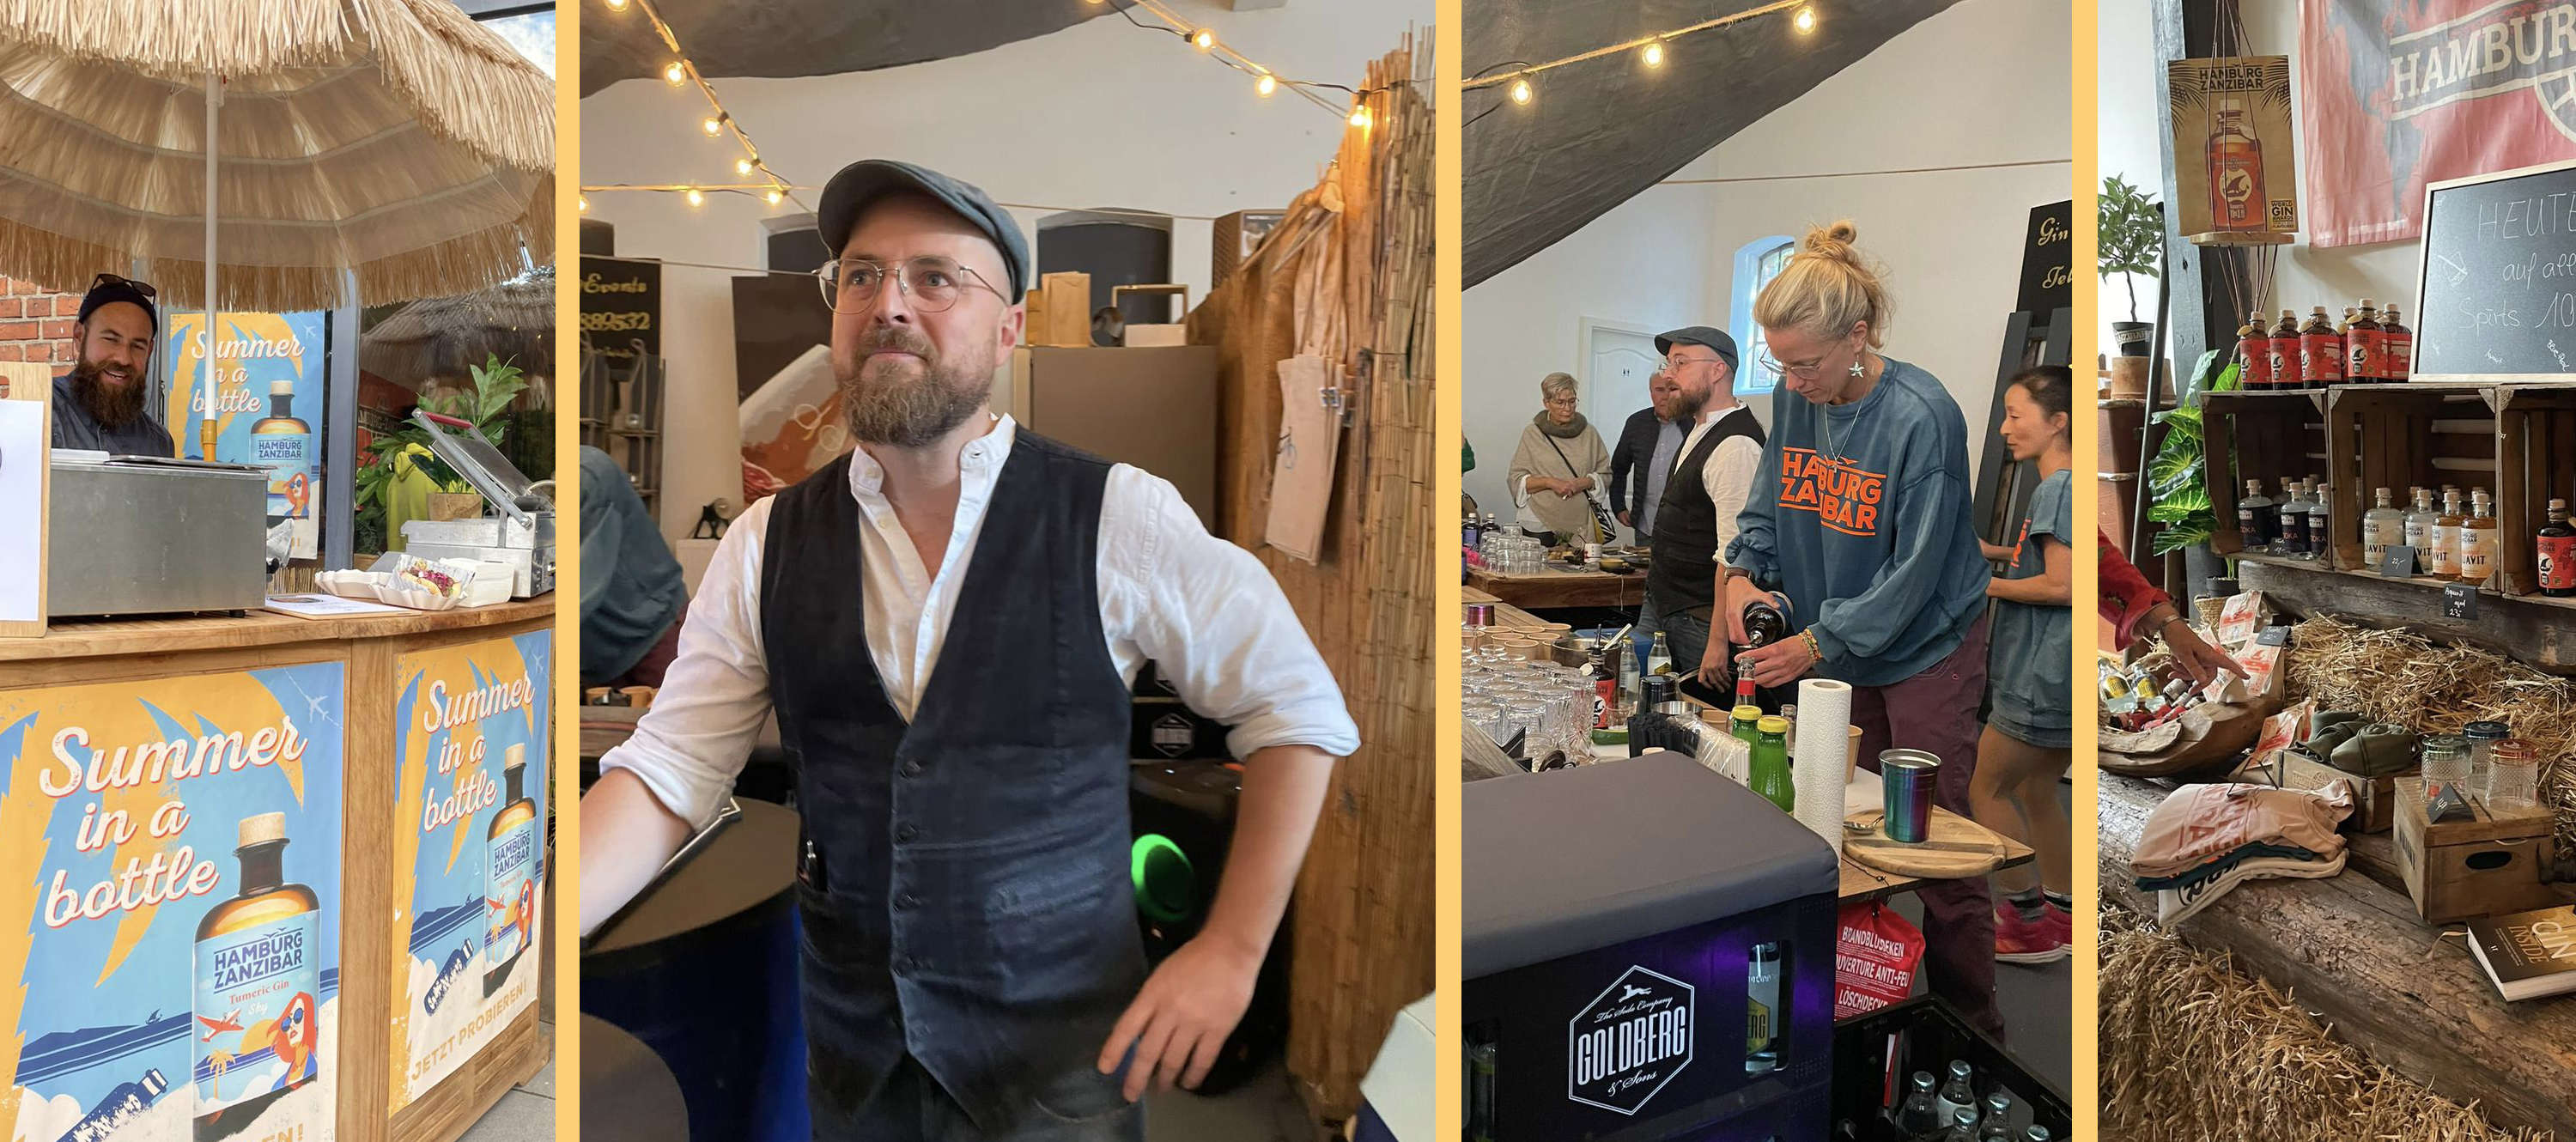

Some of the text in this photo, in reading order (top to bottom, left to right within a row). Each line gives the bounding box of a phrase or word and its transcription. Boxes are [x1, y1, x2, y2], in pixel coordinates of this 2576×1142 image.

[2200, 69, 2263, 80] HAMBURG
[2201, 78, 2263, 90] ZANZIBAR
[2271, 206, 2293, 216] GIN
[2038, 217, 2069, 246] Gin
[2502, 252, 2537, 289] auf
[191, 330, 306, 359] Summer
[231, 367, 249, 384] a
[258, 440, 302, 450] HAMBURG
[258, 450, 302, 459] ZANZIBAR
[1783, 452, 1882, 505] HABURG
[424, 670, 536, 734] Summer
[39, 715, 309, 799] Summer
[438, 735, 487, 774] in a
[423, 768, 498, 832] bottle
[74, 799, 191, 853] in a
[494, 846, 530, 878] ZANZIBAR
[495, 833, 531, 864] HAMBURG
[44, 845, 221, 930] bottle
[215, 931, 303, 971] HAMBURG
[2507, 926, 2549, 964] INSIDE
[2531, 921, 2576, 959] GIN
[214, 950, 302, 990] ZANZIBAR
[1875, 964, 1911, 987] ANTI-FEU
[228, 980, 289, 1005] Tumeric Gin
[1594, 996, 1674, 1023] The Soda Company
[411, 1035, 456, 1081] JETZT
[458, 977, 526, 1045] PROBIEREN!
[1577, 1005, 1686, 1086] GOLDBERG
[1621, 1069, 1658, 1091] Sons
